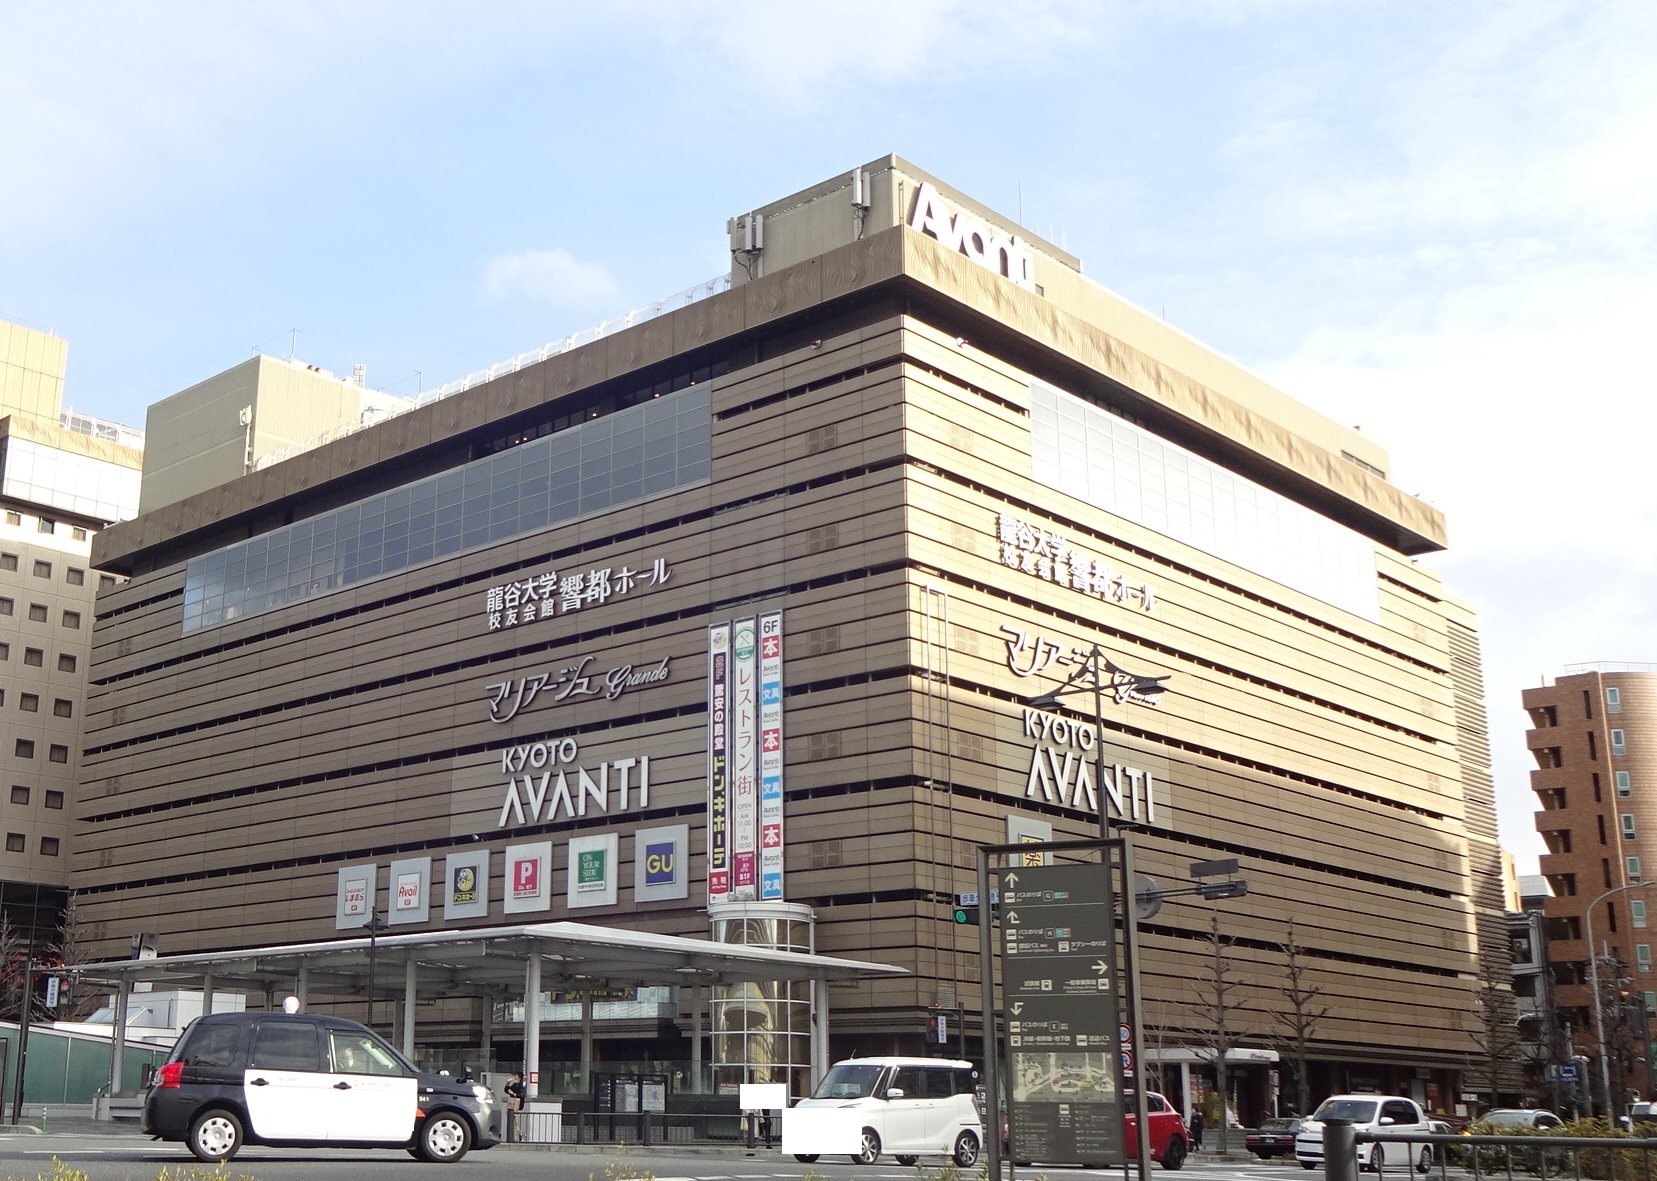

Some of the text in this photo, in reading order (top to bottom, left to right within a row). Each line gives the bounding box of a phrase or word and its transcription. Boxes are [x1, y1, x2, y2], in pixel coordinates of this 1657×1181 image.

[911, 181, 1035, 292] Avanti
[486, 557, 673, 613] 龍谷大学 響都ホール
[488, 598, 554, 631] 校友会館
[763, 620, 778, 633] 6F
[763, 637, 778, 657] 本
[485, 656, 603, 724] マリアージュ
[605, 656, 673, 701] Grande
[738, 668, 752, 796] レストラン街
[763, 731, 778, 750] 本
[1024, 708, 1094, 751] KYOTO
[502, 738, 578, 774] KYOTO
[498, 755, 649, 827] AVANTI
[1026, 743, 1154, 822] AVANTI
[764, 826, 779, 846] 本
[583, 854, 592, 862] ON
[583, 861, 600, 869] YOUR
[646, 854, 673, 874] GU
[520, 862, 533, 884] P
[582, 869, 597, 877] SIDE
[399, 885, 418, 898] Avail
